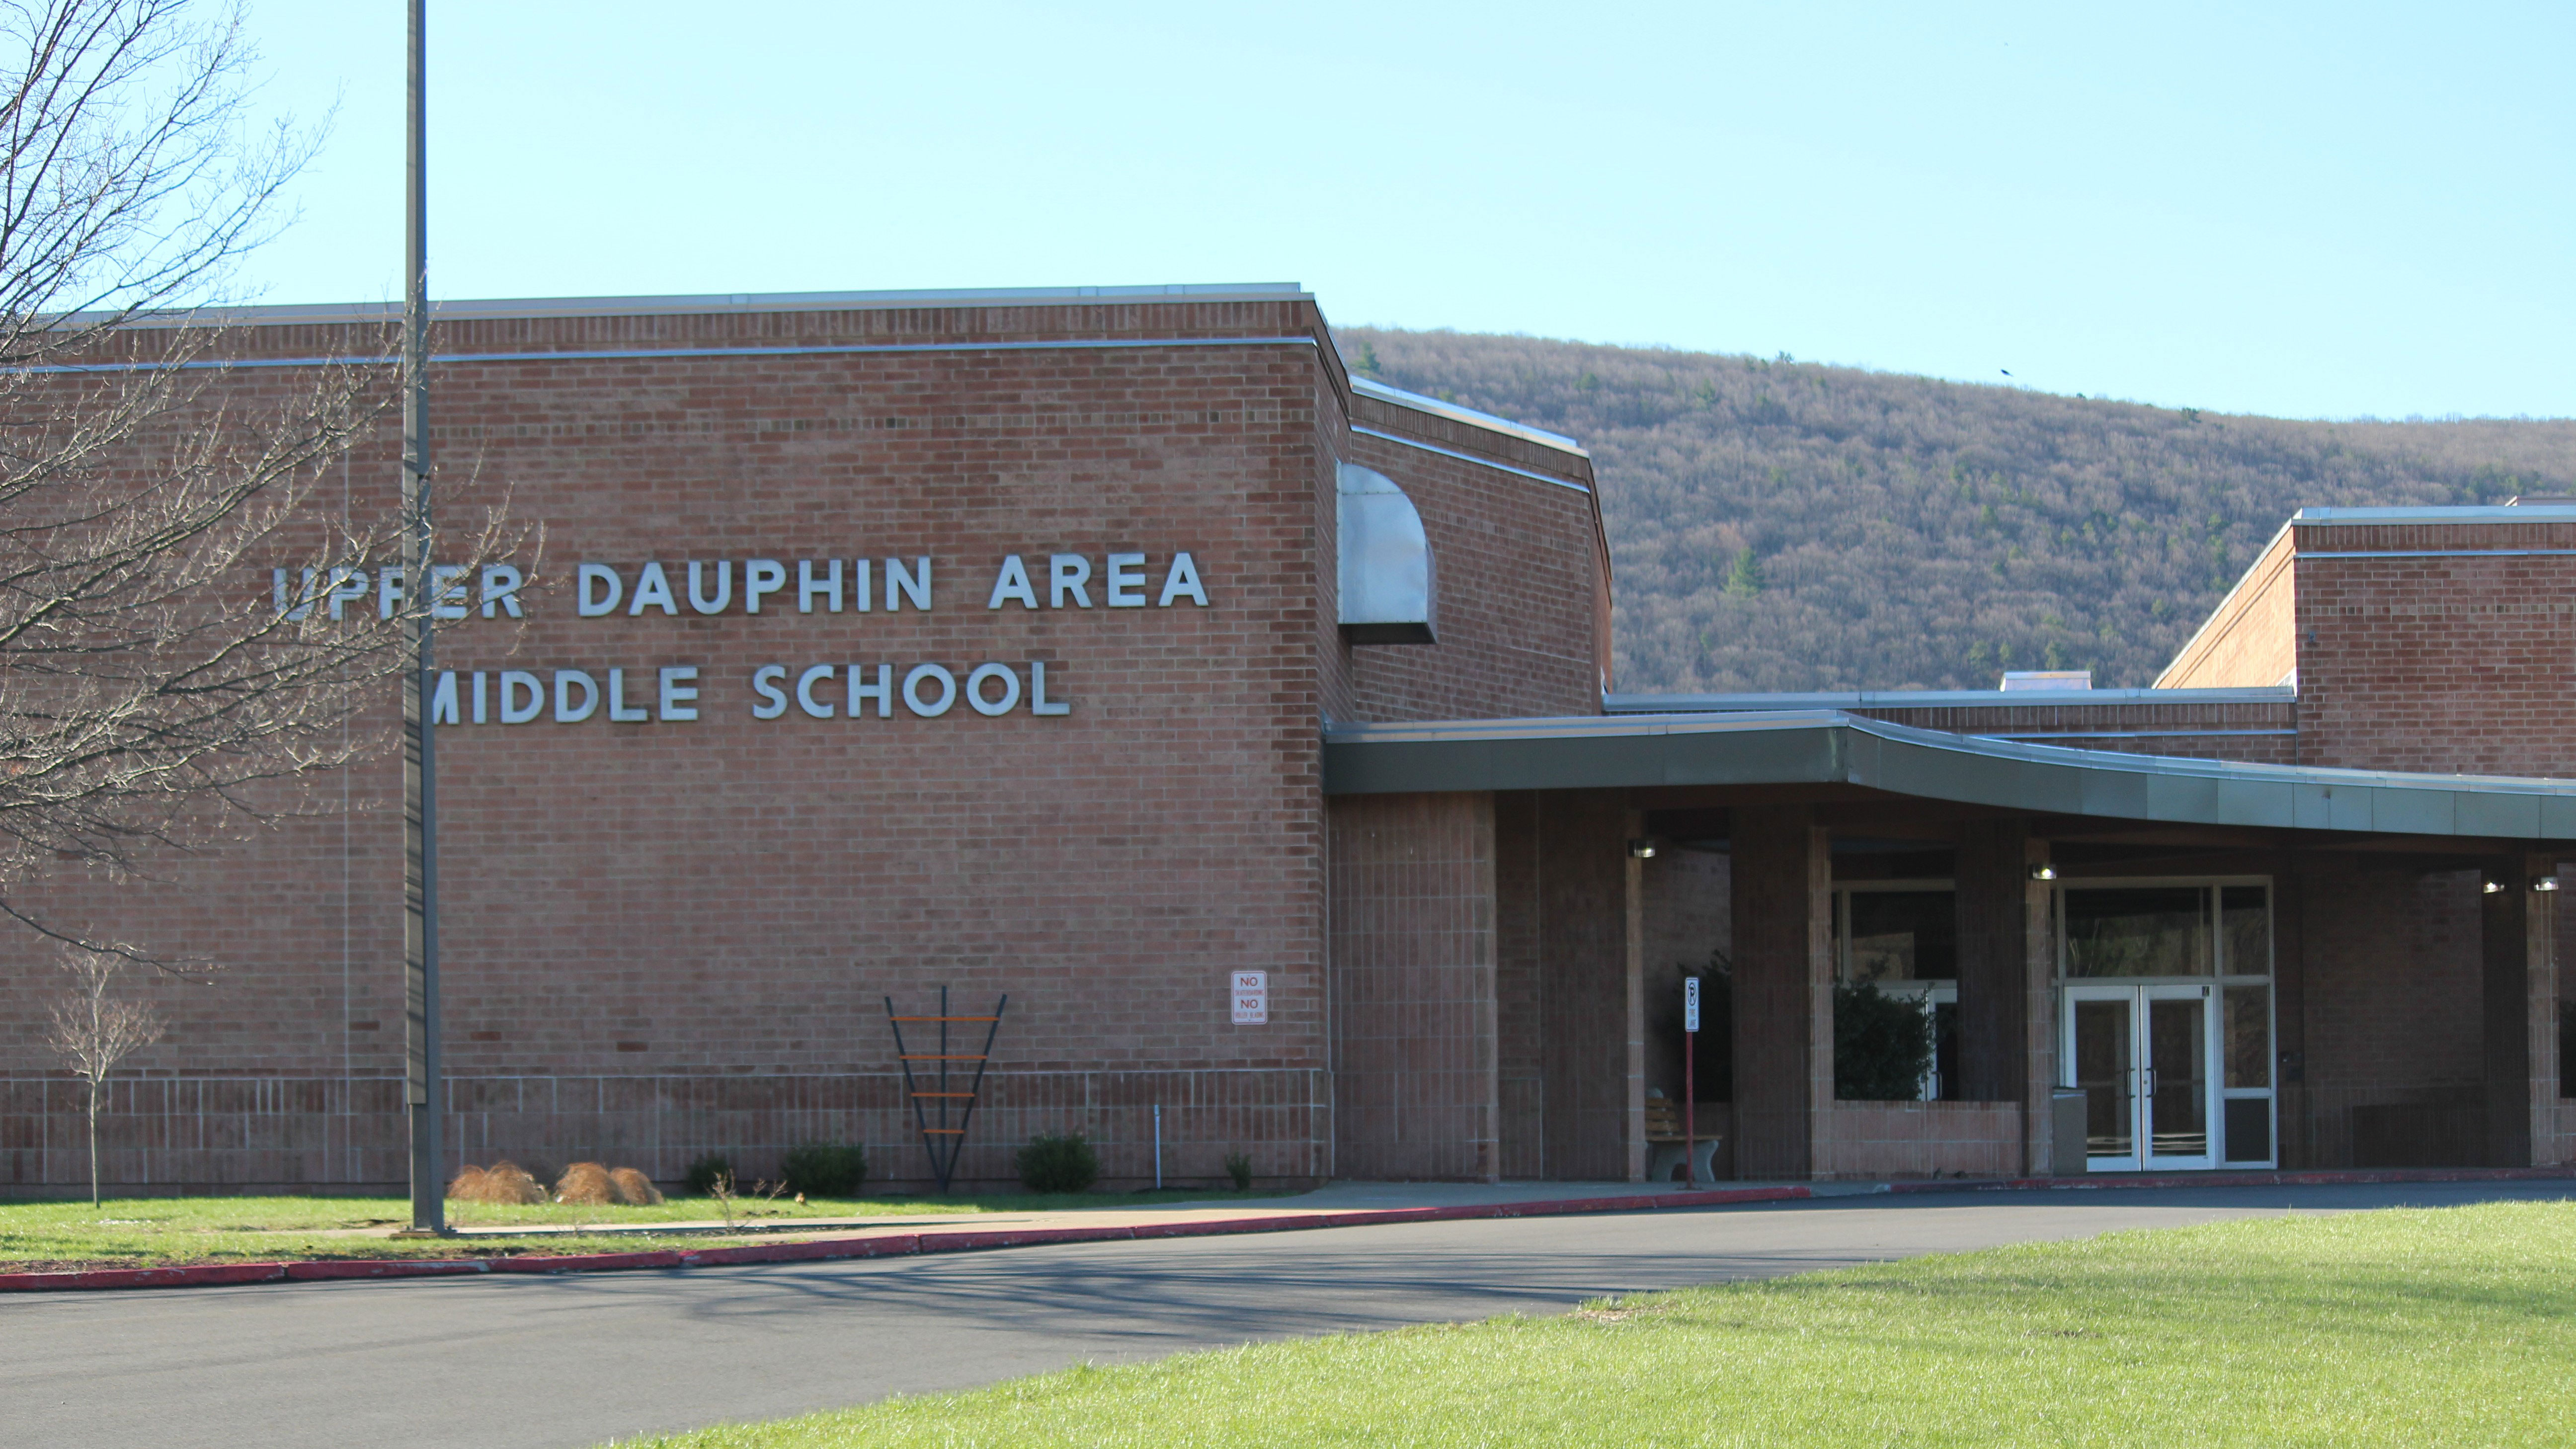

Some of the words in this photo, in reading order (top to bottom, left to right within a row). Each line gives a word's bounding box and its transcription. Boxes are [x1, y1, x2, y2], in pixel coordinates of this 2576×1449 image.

[273, 563, 523, 621] UPPER
[577, 556, 932, 617] DAUPHIN
[987, 552, 1209, 609] AREA
[752, 661, 1070, 719] SCHOOL
[1240, 977, 1258, 986] NO
[1241, 999, 1258, 1009] NO
